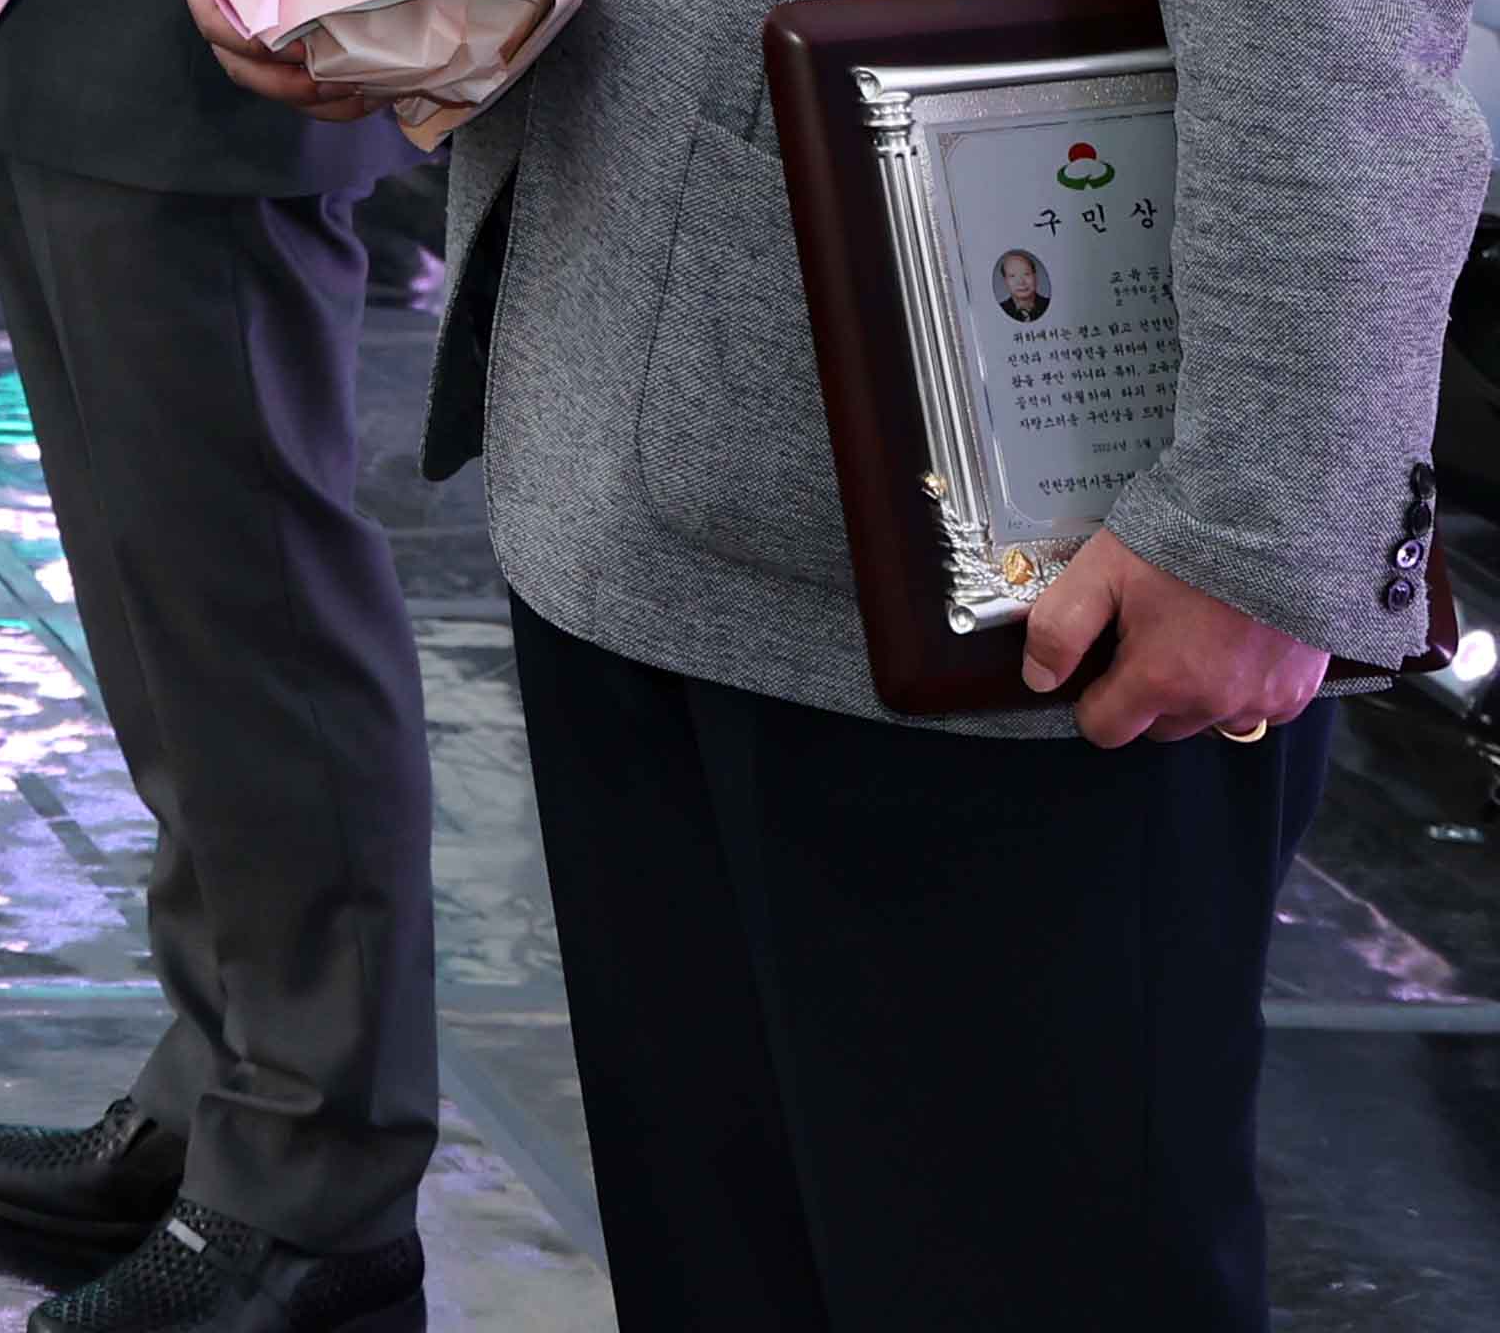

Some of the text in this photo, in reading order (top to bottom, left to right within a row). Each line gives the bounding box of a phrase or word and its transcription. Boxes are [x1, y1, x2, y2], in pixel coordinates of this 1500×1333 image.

[1034, 198, 1158, 236] 구민상
[1141, 403, 1176, 420] 드립니
[1160, 436, 1174, 447] 10
